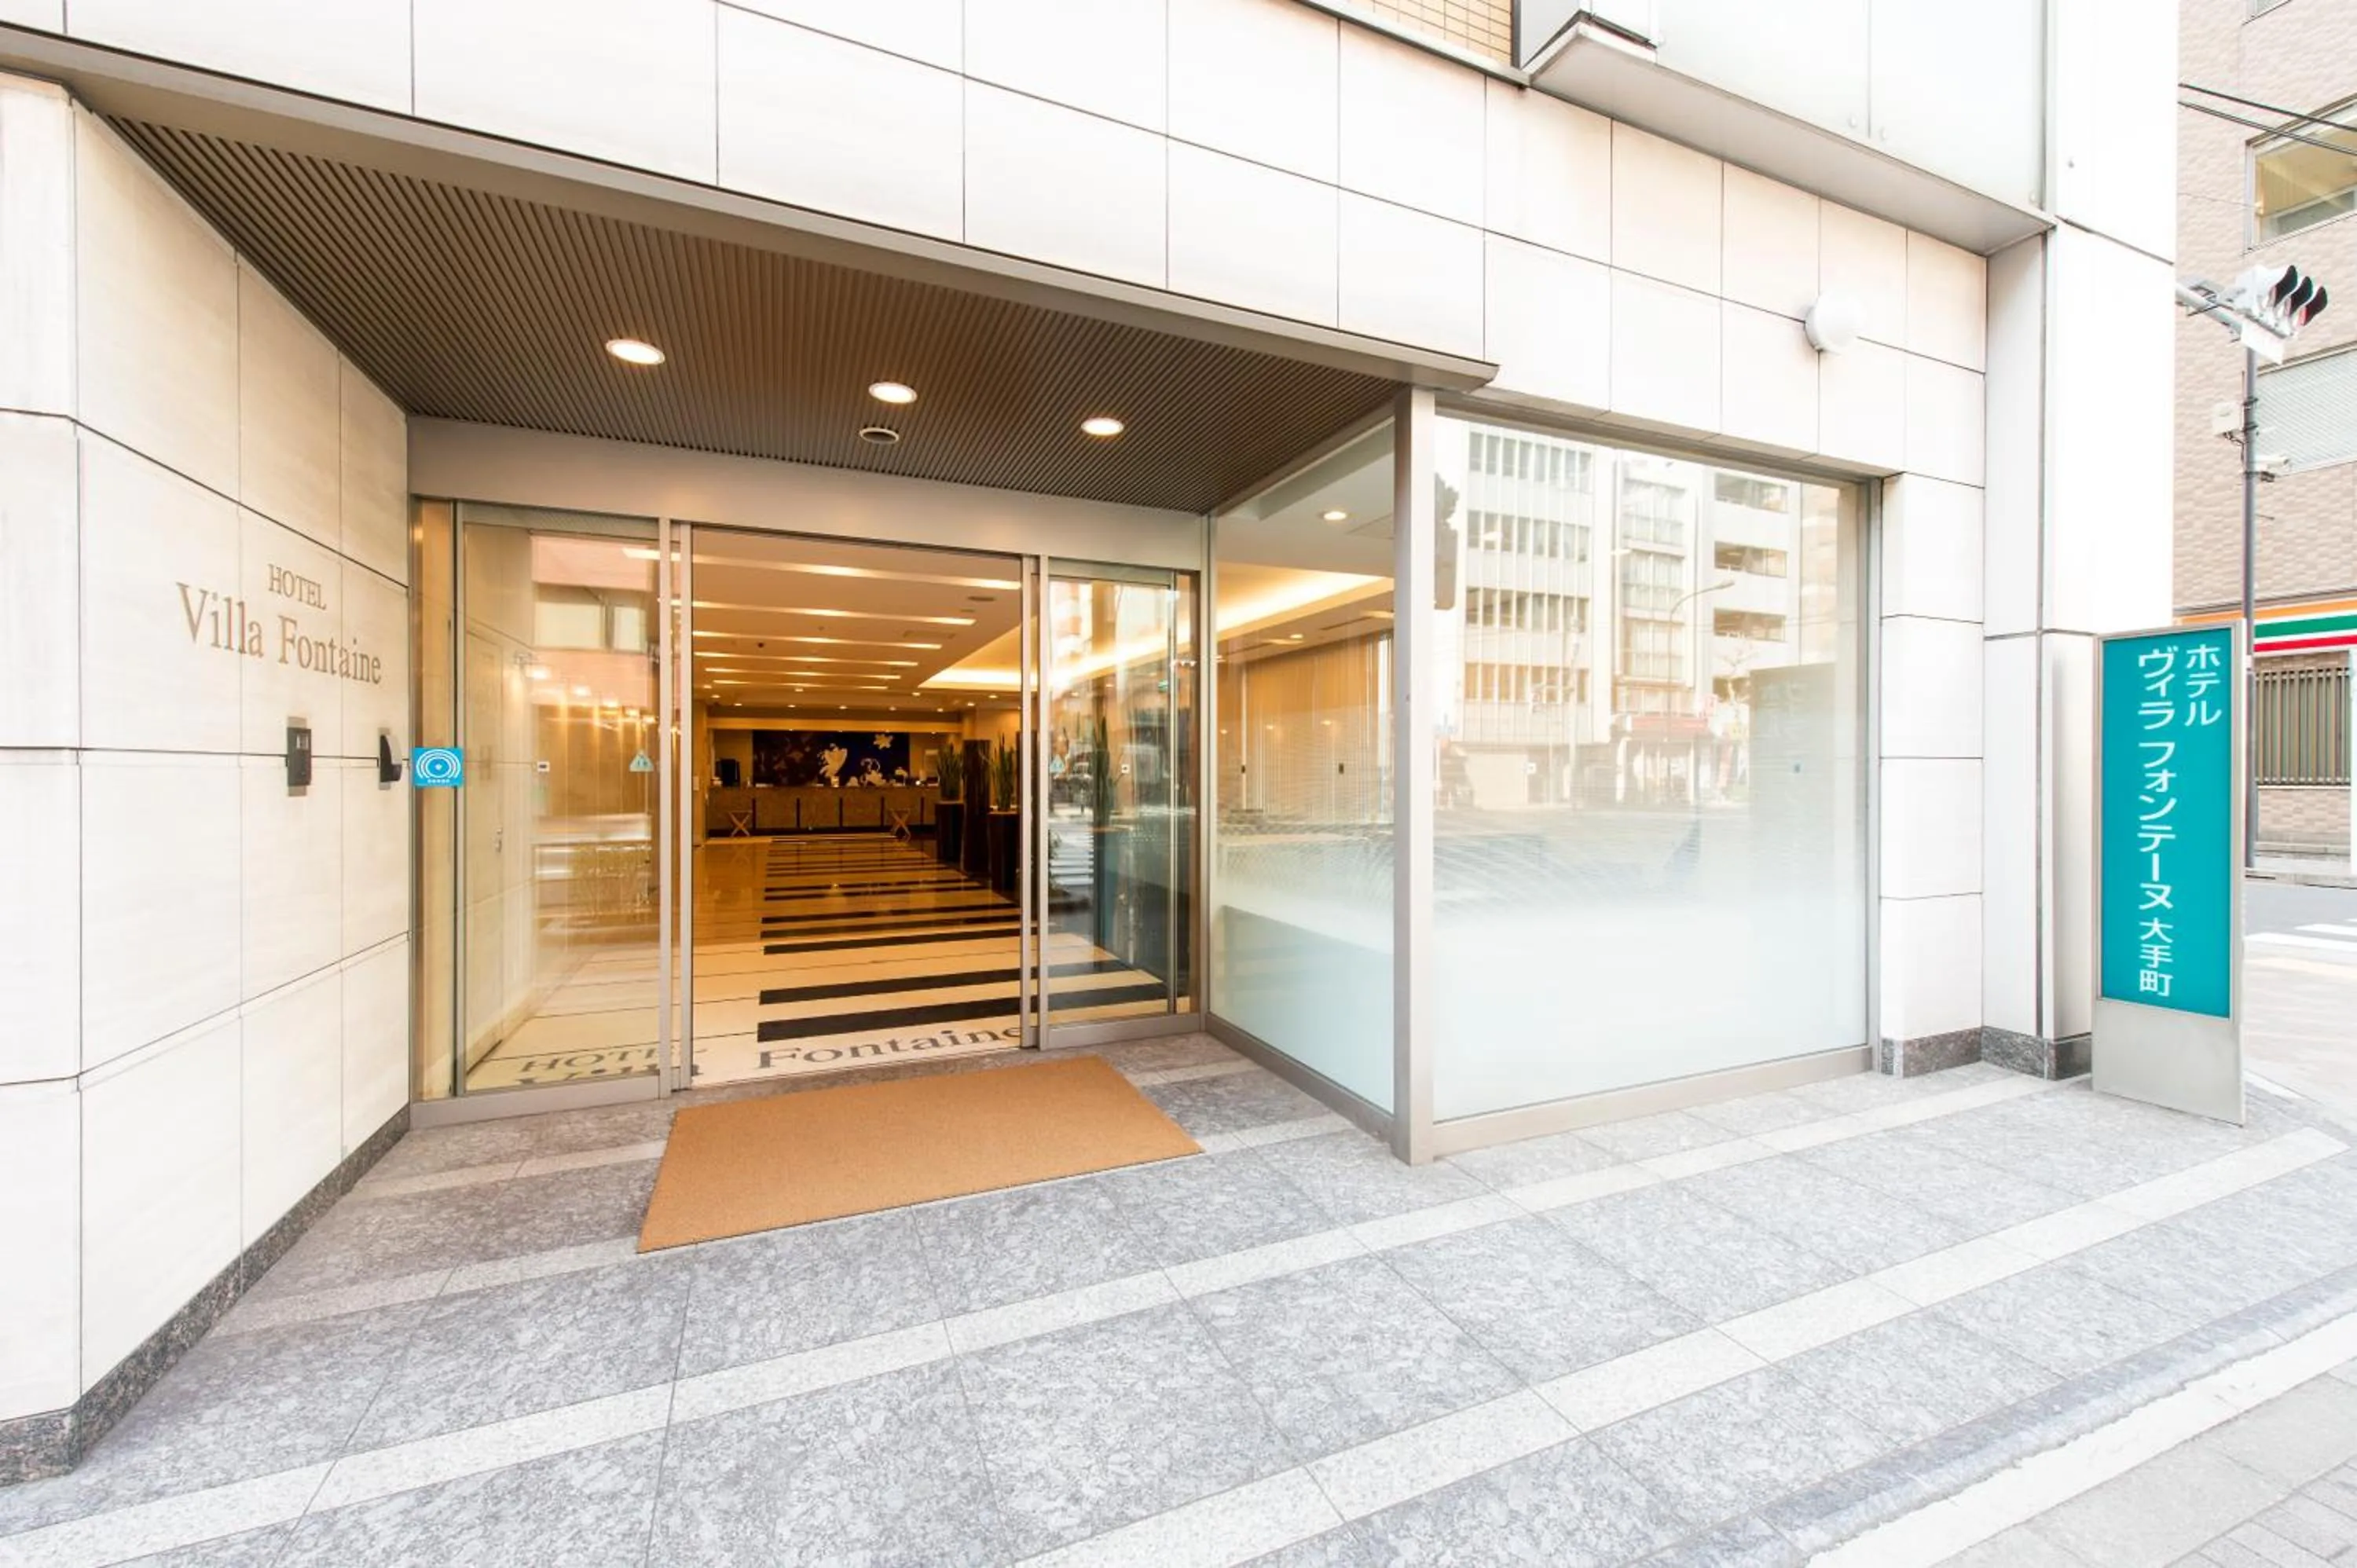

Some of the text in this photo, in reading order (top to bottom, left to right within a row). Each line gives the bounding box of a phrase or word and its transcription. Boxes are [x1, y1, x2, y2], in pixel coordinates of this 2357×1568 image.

[267, 563, 327, 610] HOTEL
[175, 581, 383, 685] Villa Fontaine
[2184, 643, 2223, 727] ホテル
